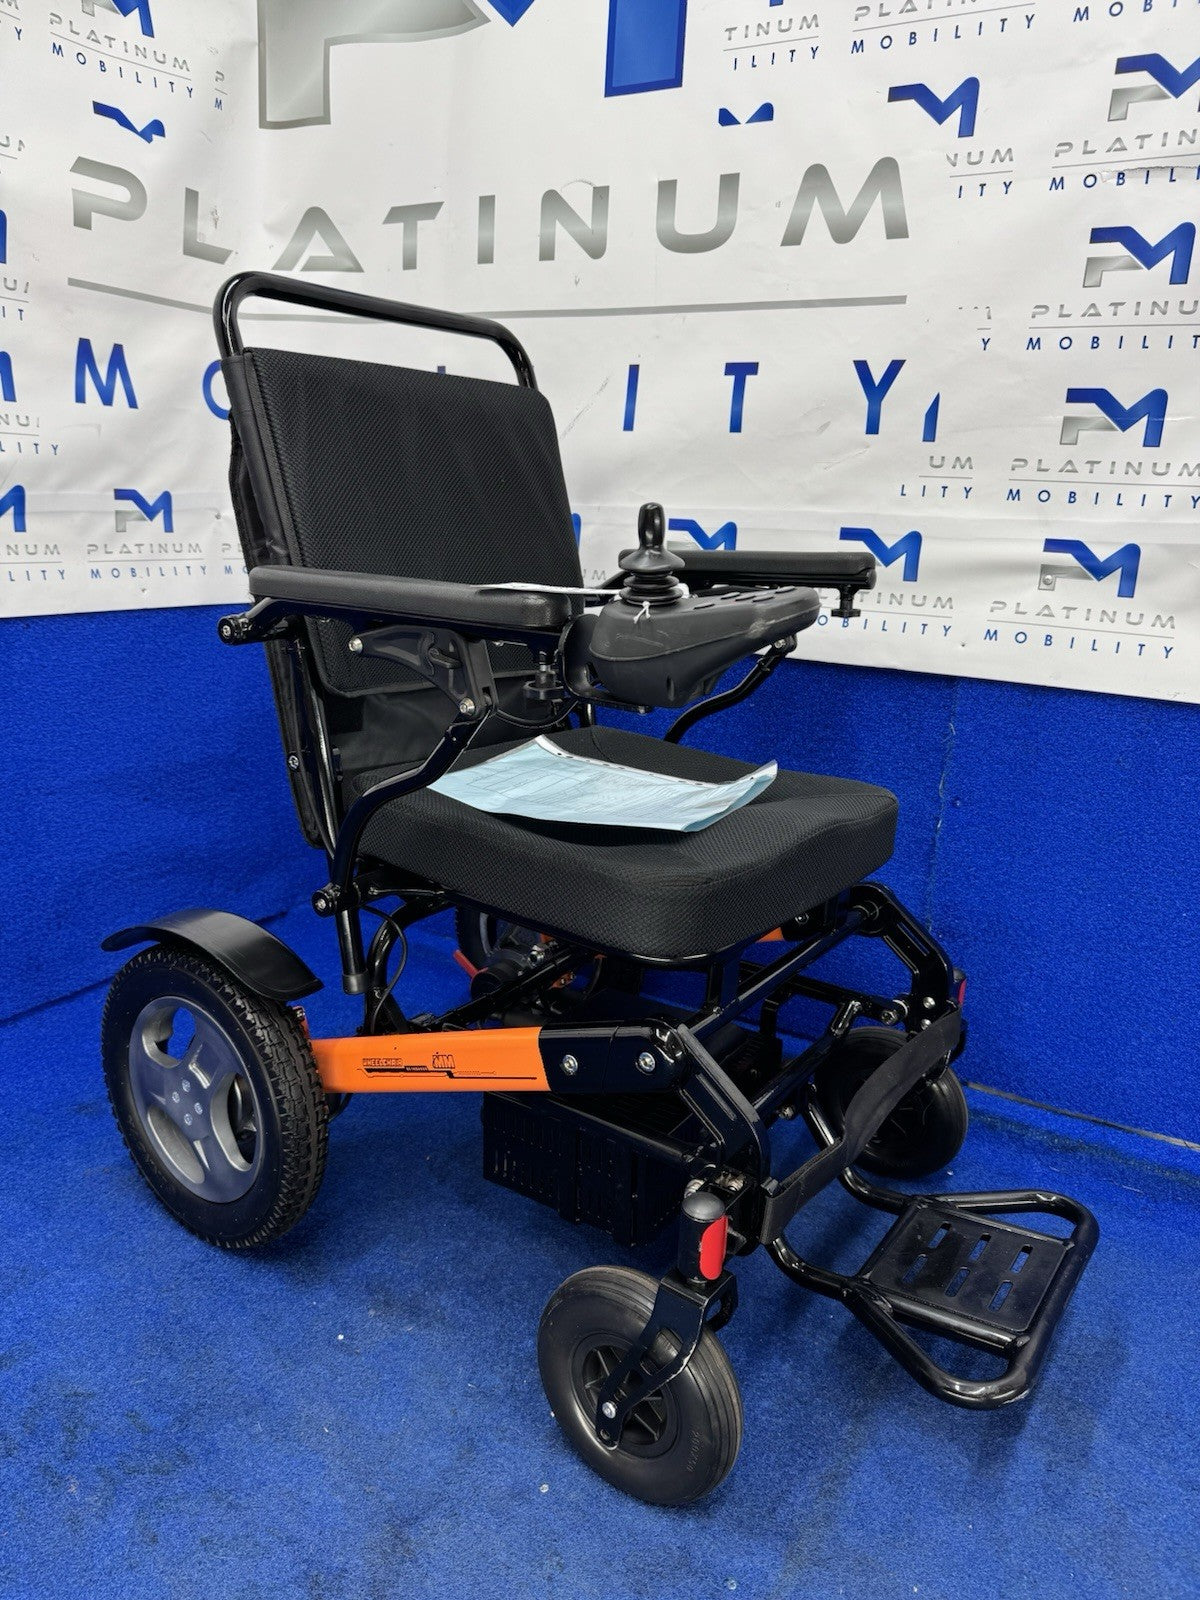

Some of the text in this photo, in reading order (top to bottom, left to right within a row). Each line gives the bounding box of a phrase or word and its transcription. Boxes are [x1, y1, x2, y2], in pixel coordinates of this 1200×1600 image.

[49, 12, 191, 72] PLATINUM
[851, 14, 1035, 54] MOBILITY
[52, 42, 194, 98] MOBILITY
[70, 155, 910, 273] PLATINUM
[1011, 457, 1200, 477] PLATINUM
[1007, 488, 1200, 509] MOBILITY
[87, 543, 203, 555] PLATINUM
[91, 565, 207, 579] MOBILITY
[817, 614, 952, 637] OBILITY
[990, 600, 1176, 630] PLATINUM
[984, 629, 1173, 659] MOBILITY
